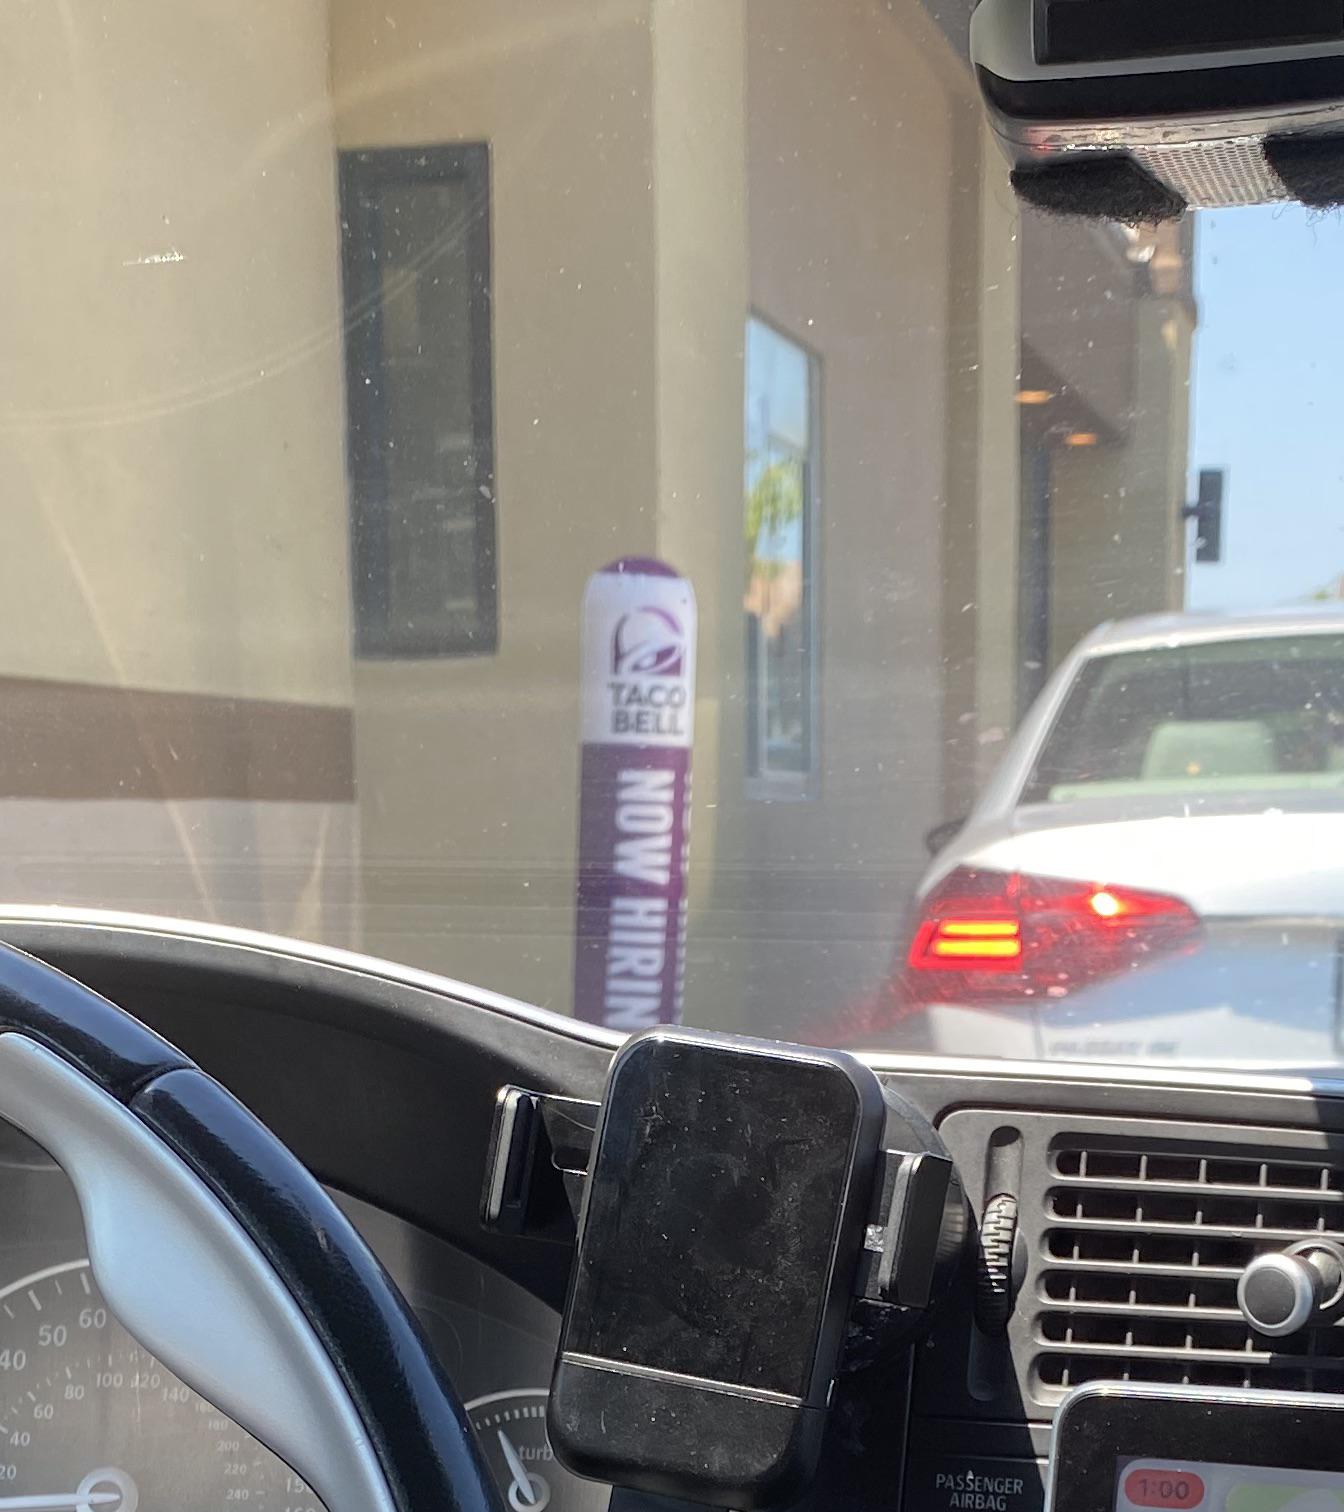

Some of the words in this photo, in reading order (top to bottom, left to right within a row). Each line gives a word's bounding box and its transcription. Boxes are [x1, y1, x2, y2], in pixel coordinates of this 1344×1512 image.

[608, 683, 687, 710] TACO
[611, 710, 684, 735] BELL
[613, 769, 676, 886] NOW
[604, 897, 669, 1028] HIRIN
[79, 1308, 107, 1329] 60
[38, 1325, 67, 1347] 50
[96, 1372, 123, 1388] 100
[64, 1385, 85, 1400] 80
[33, 1405, 54, 1419] 60
[9, 1431, 31, 1447] 40
[519, 1442, 554, 1460] turb
[935, 1473, 1024, 1495] PASSENGER
[1137, 1476, 1190, 1501] 1:00
[949, 1492, 1008, 1512] AIRBAG
